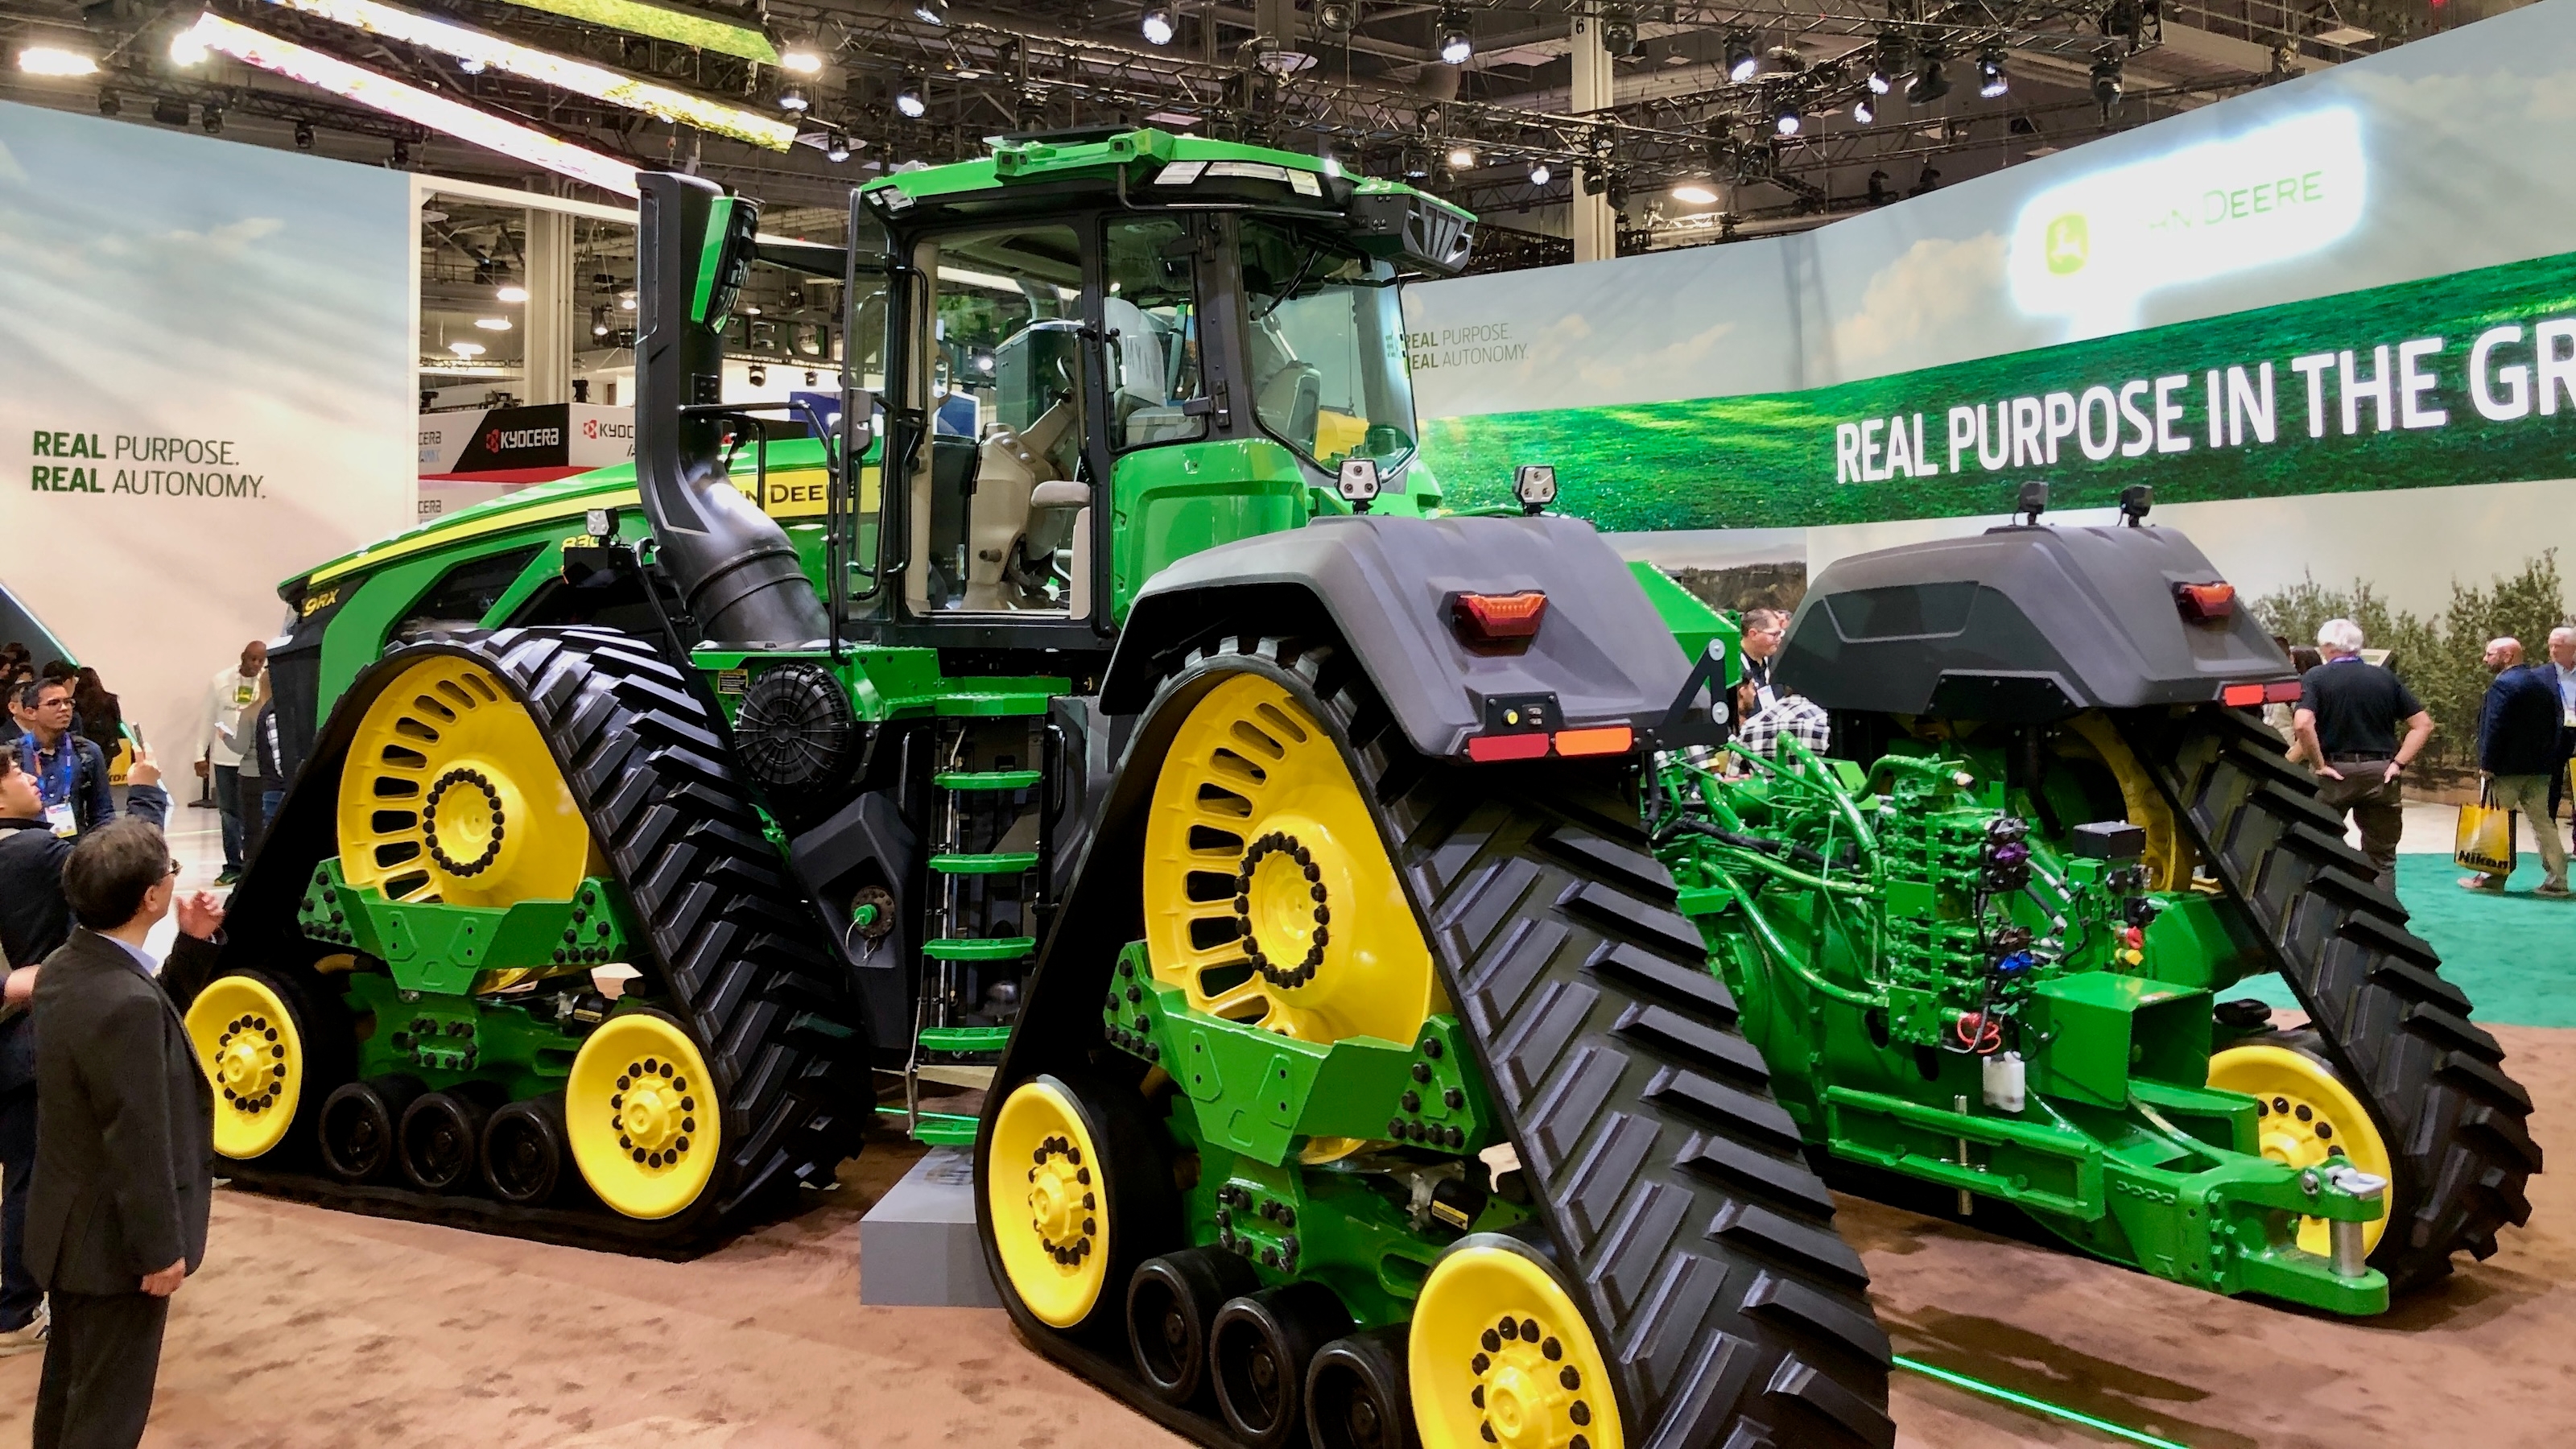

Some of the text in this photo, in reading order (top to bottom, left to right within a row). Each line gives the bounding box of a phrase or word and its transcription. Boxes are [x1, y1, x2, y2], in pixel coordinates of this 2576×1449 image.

[2203, 171, 2323, 225] DEERE
[1443, 323, 1512, 346] PURPOSE.
[1410, 344, 1530, 370] EAL AUTONOMY.
[1836, 318, 2576, 485] REAL PURPOSE IN THE GR
[500, 427, 559, 449] KYOCERA
[600, 423, 634, 439] KYOC
[32, 431, 240, 466] REAL PURPOSE.
[31, 465, 266, 499] REAL AUTONOMY.
[303, 588, 340, 617] 9RX
[2458, 850, 2509, 869] Nikon
